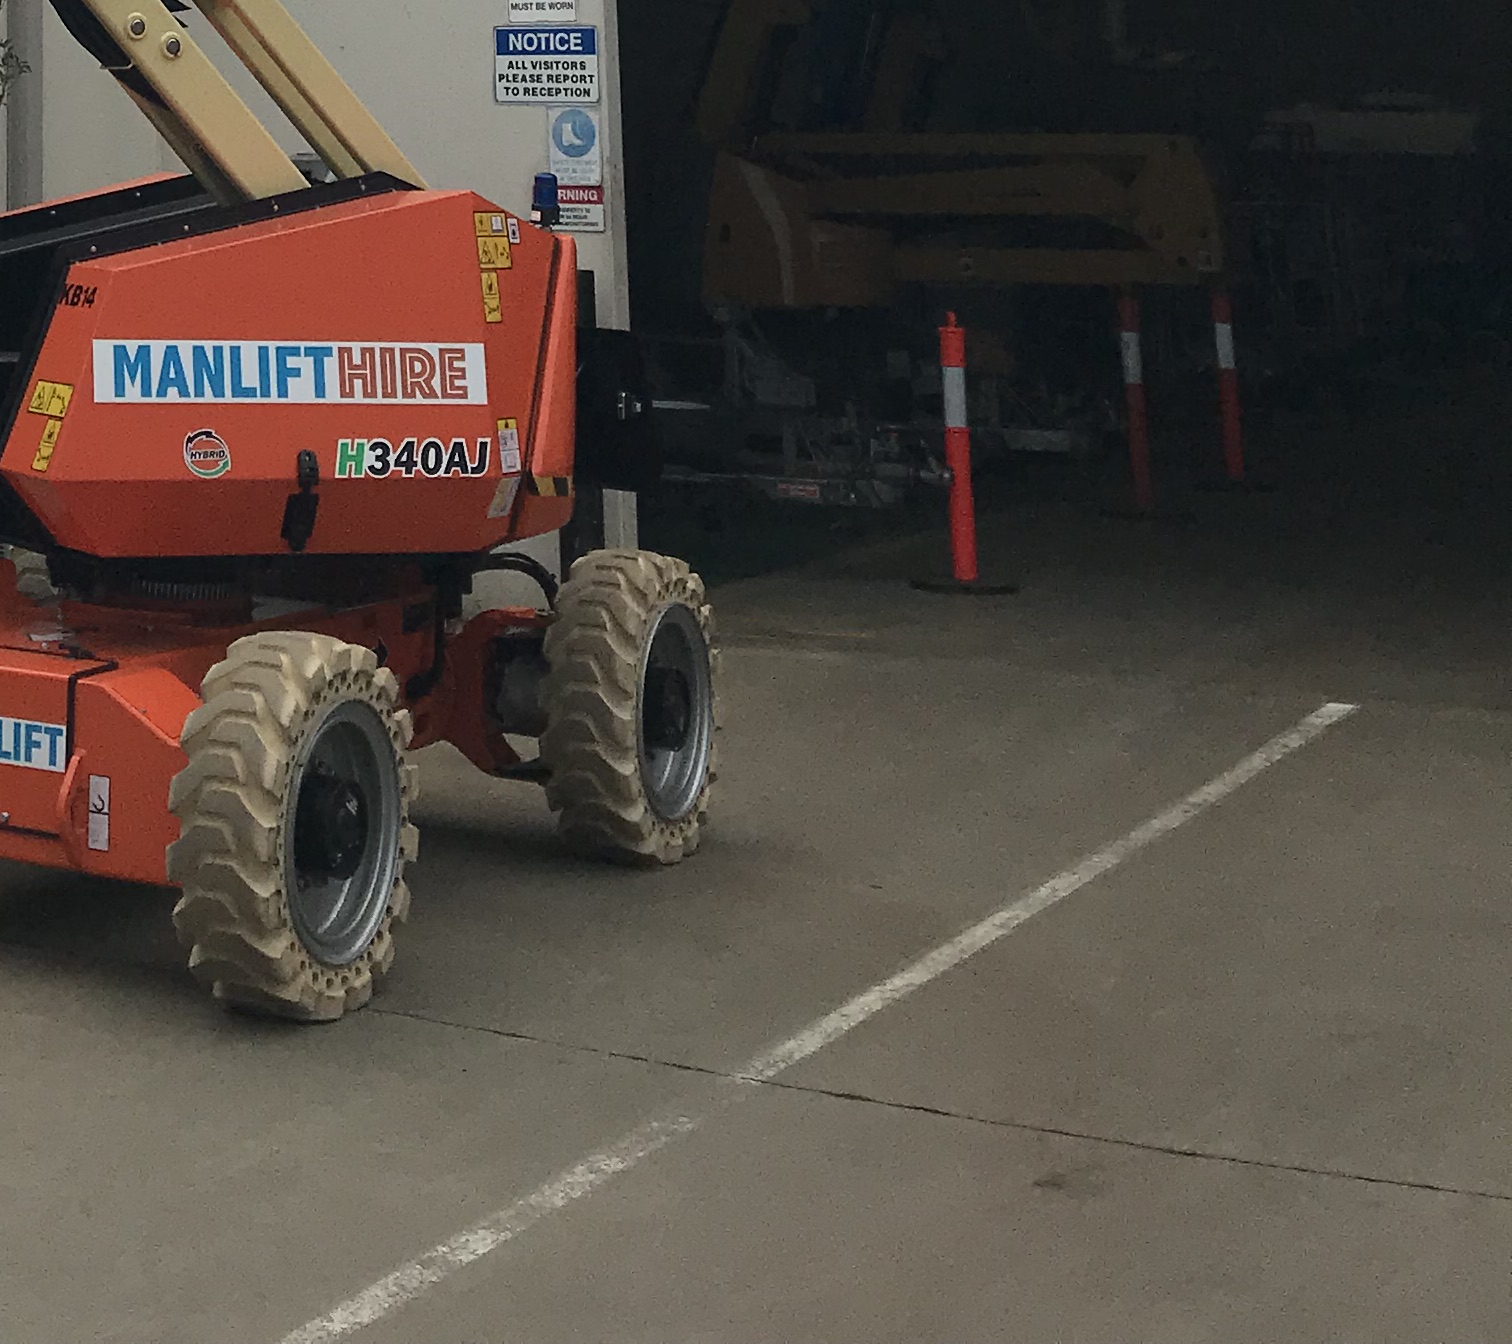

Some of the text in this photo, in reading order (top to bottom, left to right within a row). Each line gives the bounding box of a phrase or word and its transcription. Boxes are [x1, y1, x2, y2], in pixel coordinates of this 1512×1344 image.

[511, 2, 574, 11] MUST BE WORN
[508, 33, 583, 51] NOTICE
[507, 60, 586, 70] ALL VISITORS
[498, 74, 595, 84] PLEASE REPORT
[504, 86, 591, 97] TO RECEPTION
[557, 189, 598, 201] RNING
[59, 283, 98, 308] KB14
[190, 450, 226, 460] HYBRID
[337, 438, 489, 477] H340AJ
